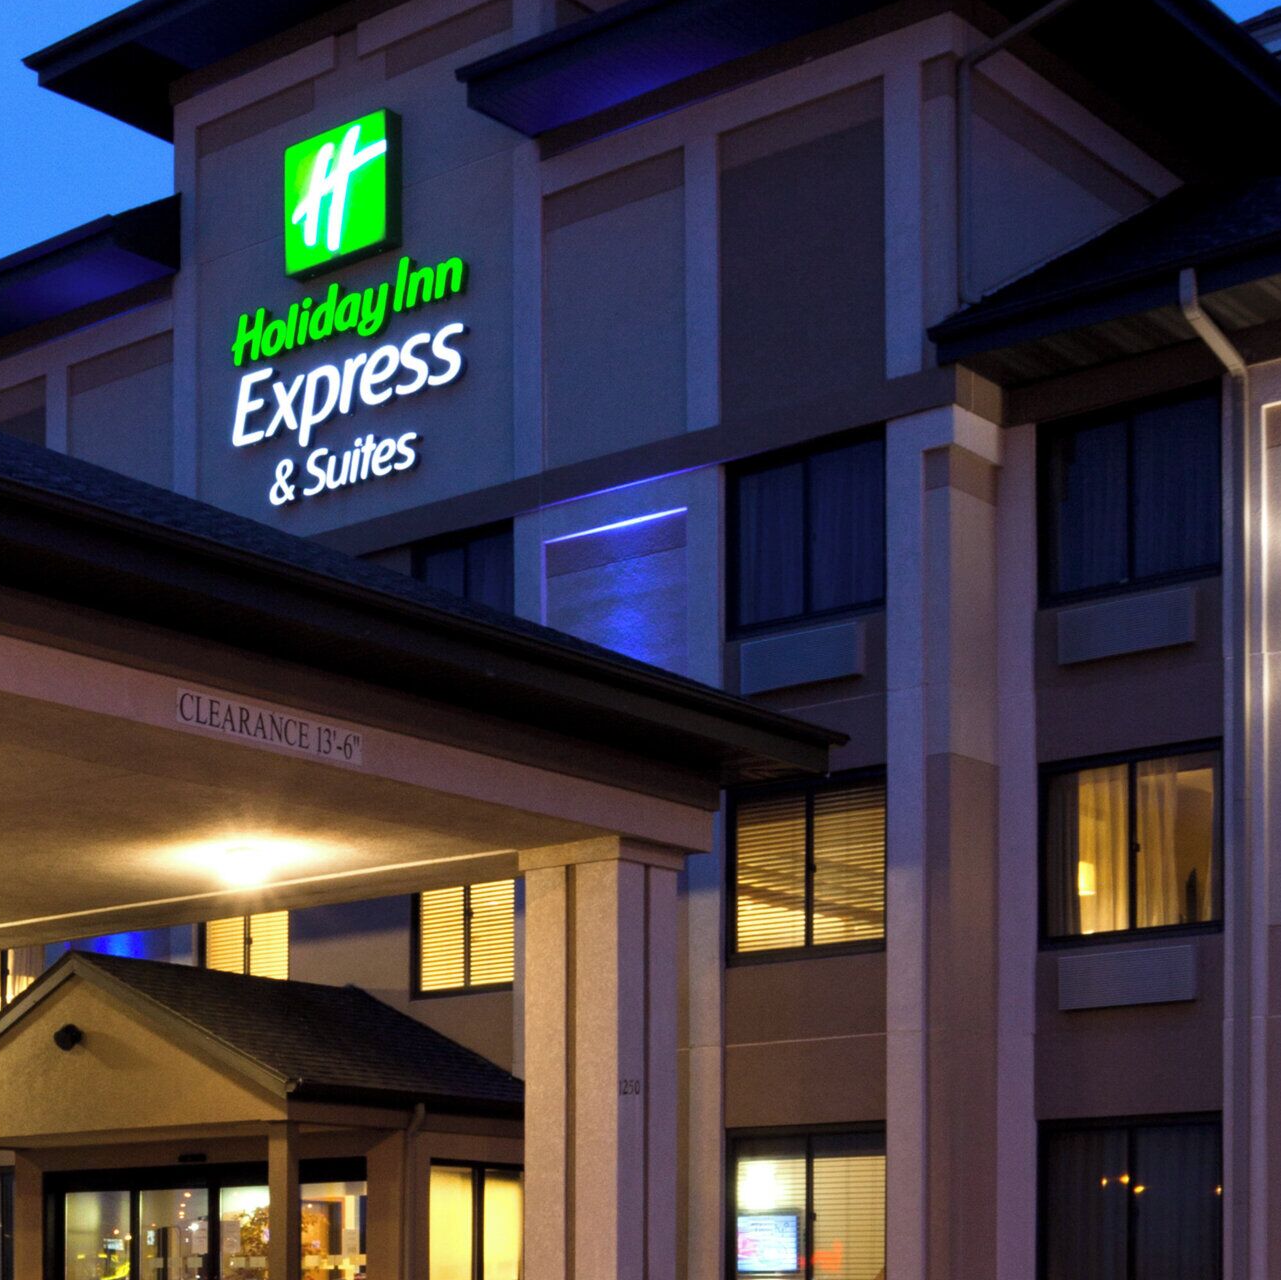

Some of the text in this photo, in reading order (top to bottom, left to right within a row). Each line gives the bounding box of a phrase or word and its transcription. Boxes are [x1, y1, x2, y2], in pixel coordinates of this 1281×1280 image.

[232, 256, 463, 366] Holiday Inn
[232, 323, 464, 447] Express
[269, 431, 418, 505] & Suites
[179, 693, 309, 749] CLEARANCE
